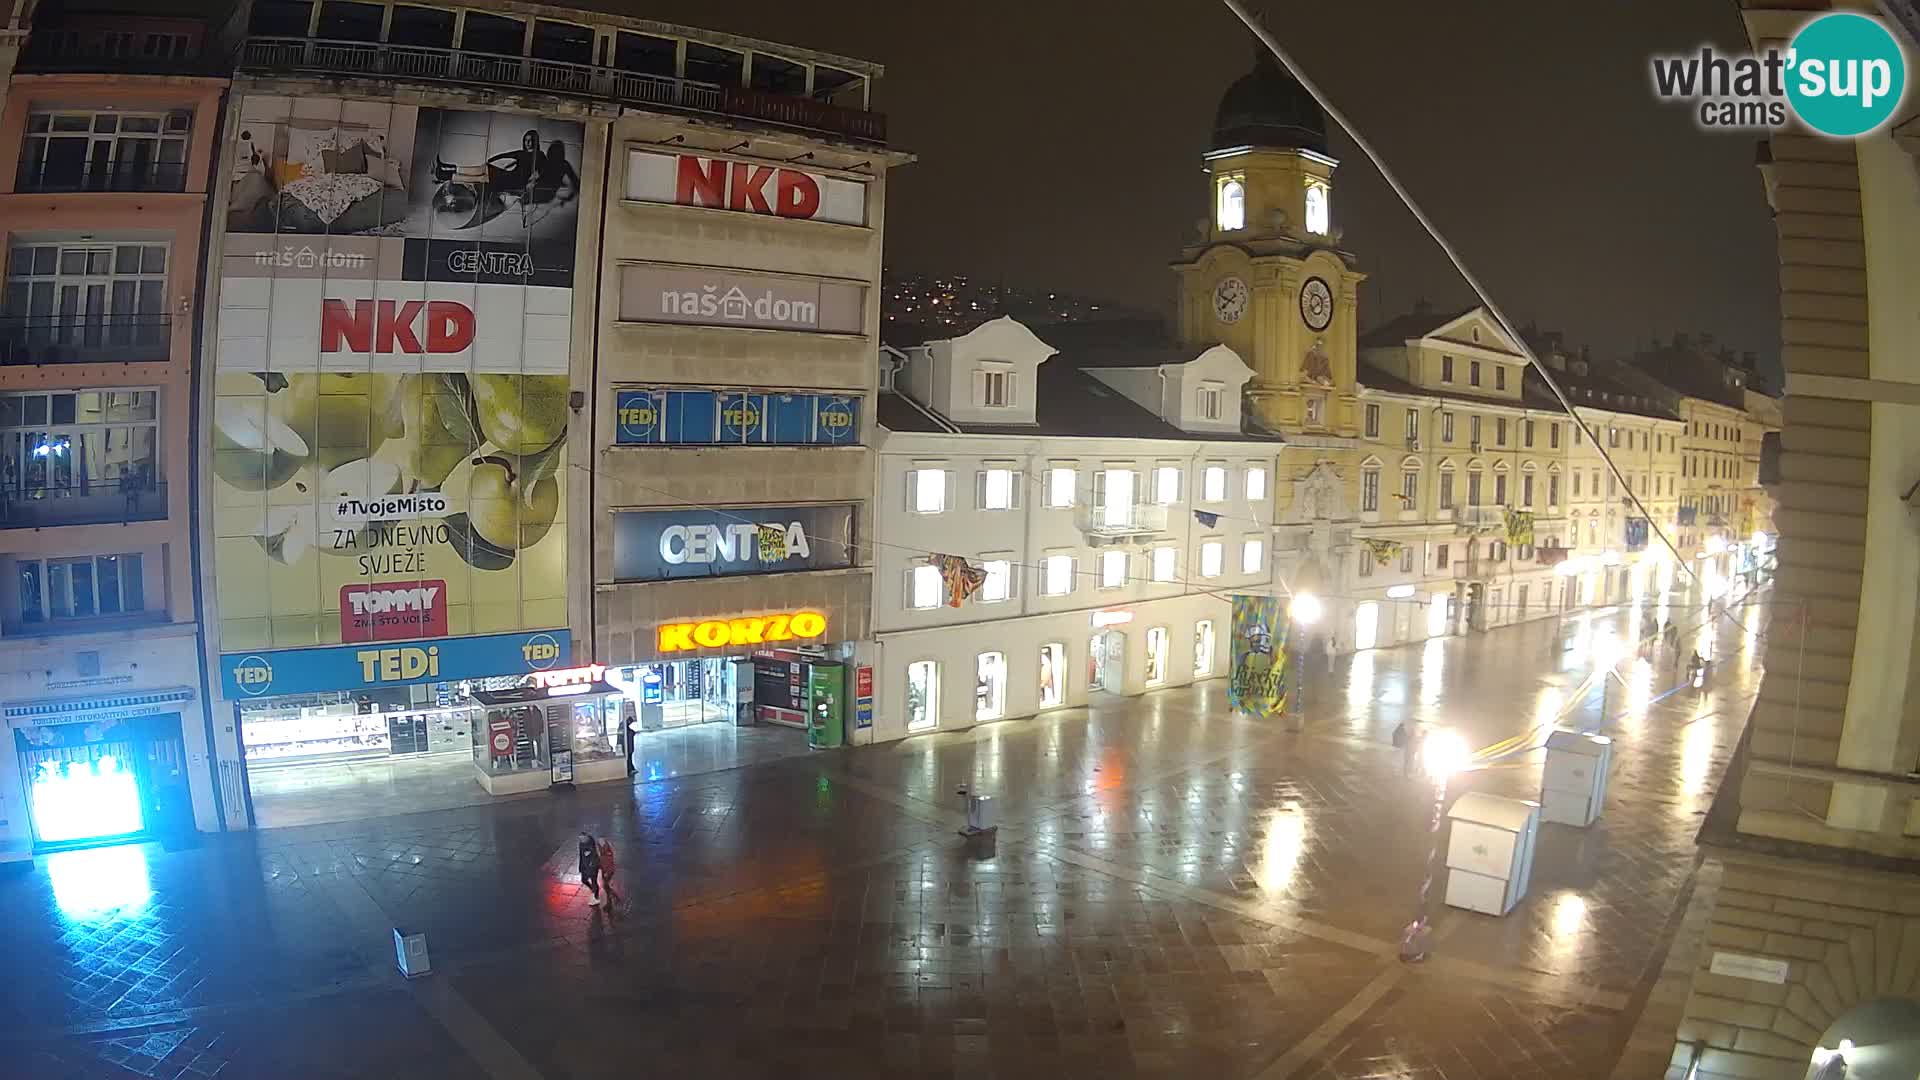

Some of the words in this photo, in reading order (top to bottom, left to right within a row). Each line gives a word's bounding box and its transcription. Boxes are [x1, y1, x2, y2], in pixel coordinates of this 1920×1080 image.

[675, 153, 820, 220] NKD
[255, 245, 294, 267] naš
[319, 247, 365, 269] dom
[448, 250, 535, 277] CENTRA
[661, 285, 718, 318] naš
[753, 290, 816, 324] dom
[320, 298, 477, 354] NKD
[618, 407, 658, 426] TEDi
[723, 409, 760, 427] TEDi
[820, 411, 852, 428] TEDi
[337, 497, 446, 517] #TvojeMisto
[333, 528, 358, 550] ZA
[366, 524, 451, 548] DNEVNO
[359, 547, 426, 576] SVJEŽE
[348, 587, 440, 615] TOMMY
[657, 611, 827, 653] KORZO
[357, 646, 439, 683] TEDi
[521, 644, 560, 661] TEDi
[233, 666, 273, 684] TEDi
